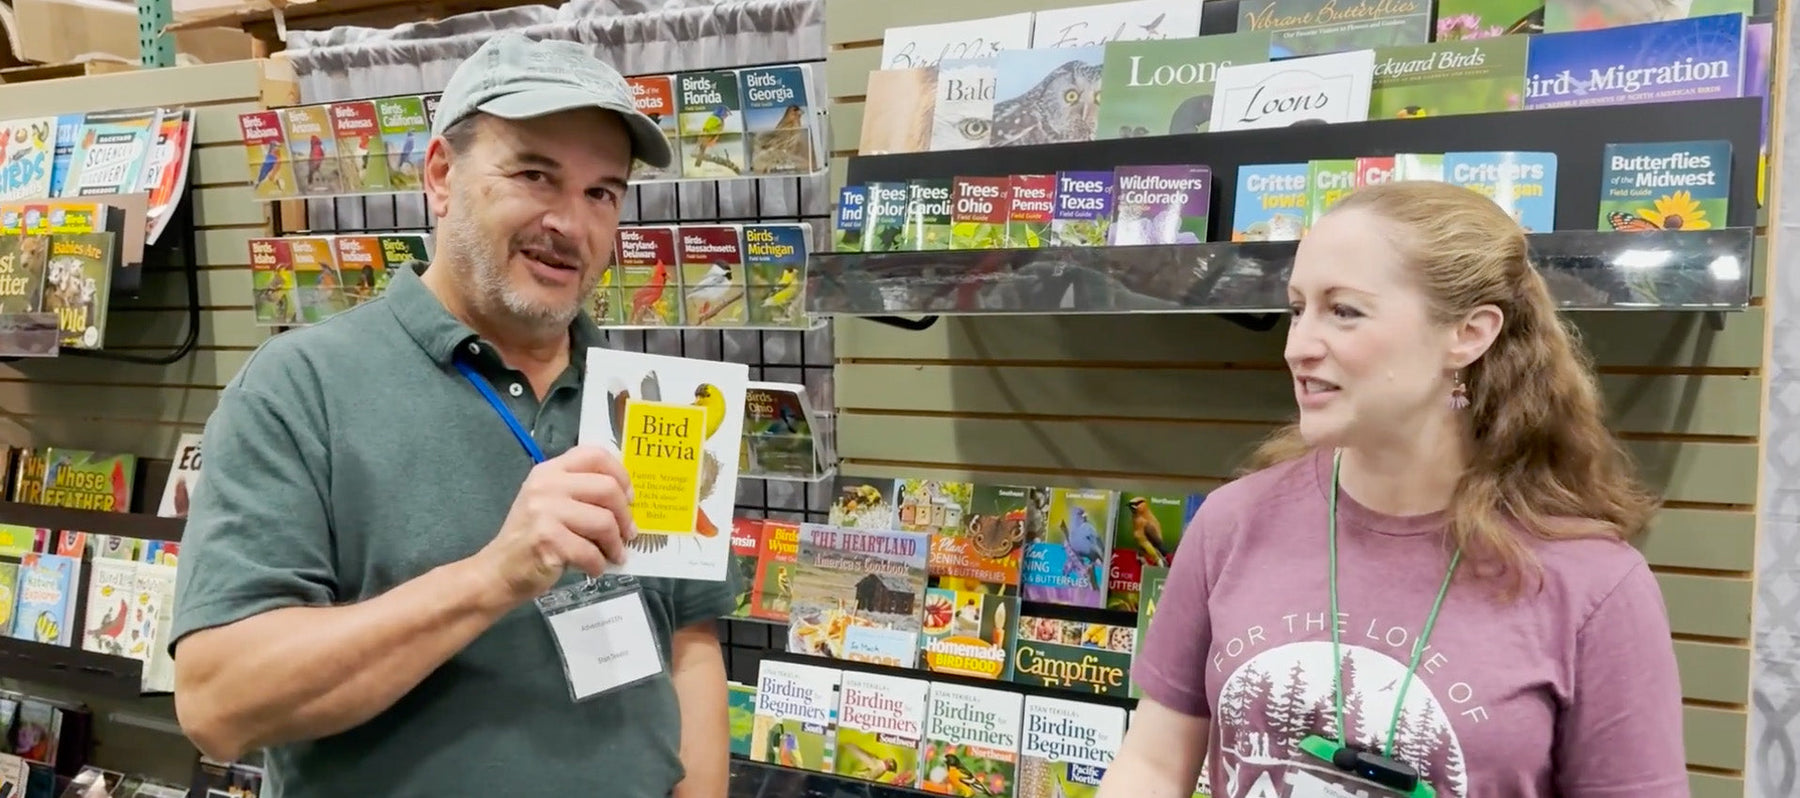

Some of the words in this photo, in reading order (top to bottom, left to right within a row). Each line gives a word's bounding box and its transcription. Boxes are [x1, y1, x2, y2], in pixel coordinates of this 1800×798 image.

[1245, 1, 1314, 33] Vibrant
[1316, 0, 1419, 26] Butterflies
[1440, 47, 1486, 69] Birds
[746, 73, 776, 88] Birds
[1588, 57, 1730, 93] Migration
[682, 77, 711, 92] Birds
[945, 77, 998, 102] Bald
[684, 90, 722, 106] Florida
[748, 86, 795, 103] Georgia
[632, 96, 663, 110] kotas
[1238, 85, 1329, 123] Loons
[383, 112, 424, 128] California
[1611, 151, 1712, 171] Butterflies
[1454, 160, 1544, 181] Critters
[1610, 175, 1619, 184] of
[1620, 175, 1634, 185] the
[1634, 169, 1716, 188] Midwest
[958, 182, 999, 198] Trees
[1060, 177, 1103, 193] Trees
[1120, 175, 1202, 191] Wildflowers
[1246, 173, 1306, 193] Critte
[843, 191, 864, 206] Tre
[867, 186, 906, 201] Trees
[909, 185, 949, 200] Trees
[1012, 187, 1046, 199] Trees
[1126, 190, 1189, 205] Colorado
[1609, 187, 1628, 197] Field
[1630, 187, 1653, 197] Guide
[867, 201, 904, 216] Color
[957, 198, 994, 214] Ohio
[1011, 199, 1054, 214] Pennsy
[1059, 194, 1105, 210] Texas
[1262, 192, 1308, 210] Iowa
[841, 206, 863, 222] Ind
[621, 231, 639, 242] Birds
[683, 235, 702, 246] Birds
[746, 229, 774, 243] Birds
[622, 239, 654, 252] Maryland
[685, 242, 737, 255] Massachusetts
[748, 242, 794, 258] Michigan
[622, 248, 656, 260] Delaware
[749, 402, 774, 413] Ohio
[642, 414, 689, 438] Bird
[630, 436, 695, 461] Trivia
[55, 463, 105, 490] Whose
[768, 538, 799, 554] Wyom
[811, 530, 837, 548] THE
[843, 532, 917, 558] HEARTLAND
[939, 536, 970, 555] Plant
[813, 552, 862, 572] America's
[864, 558, 911, 577] Cookbook
[1034, 575, 1089, 589] BUTTERFLIES
[927, 636, 1006, 661] Homemade
[935, 652, 965, 668] BIRD
[966, 657, 996, 674] FOOD
[1015, 645, 1123, 687] Campfire
[1212, 624, 1267, 673] FOR
[1282, 612, 1350, 641] THE
[1366, 618, 1449, 675] LOVE
[1447, 682, 1489, 723] OF
[762, 677, 814, 705] Birding
[759, 693, 826, 720] Beginners
[845, 687, 903, 719] Birding
[842, 705, 918, 734] Beginners
[933, 698, 996, 730] Birding
[931, 717, 1013, 748] Beginners
[1028, 714, 1096, 747] Birding
[1025, 732, 1116, 761] Beginners
[1072, 763, 1101, 777] Pacific
